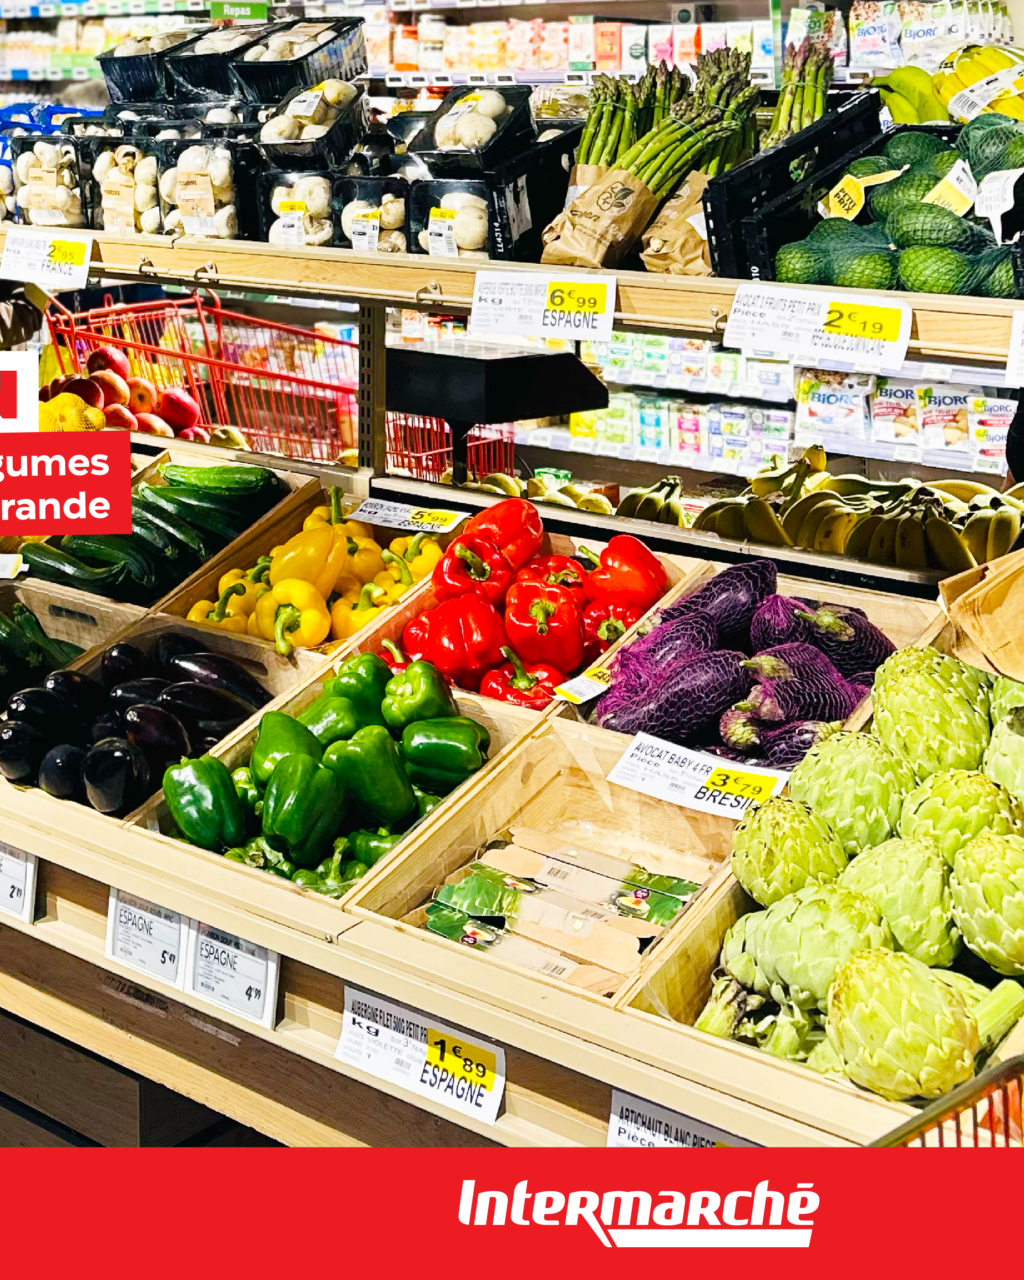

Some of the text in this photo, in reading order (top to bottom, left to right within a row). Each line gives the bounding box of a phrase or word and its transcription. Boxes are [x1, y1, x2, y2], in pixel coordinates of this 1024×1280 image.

[223, 4, 251, 18] Repas
[833, 192, 853, 214] PRIX
[838, 187, 858, 209] PETIT
[40, 260, 75, 276] FRANCE
[542, 308, 599, 329] ESPAGNE
[879, 387, 915, 400] BjOR
[629, 753, 661, 768] Pièce
[634, 741, 669, 761] AVOCAT
[668, 753, 693, 770] BABY
[692, 762, 698, 772] 4
[119, 908, 154, 937] ESPAGNE
[199, 941, 238, 972] ESPAGNE
[351, 999, 379, 1027] AUBERGINE
[379, 1008, 393, 1032] FILET
[351, 1017, 380, 1037] kg
[367, 1037, 403, 1056] VIOLETTE
[434, 1039, 487, 1078] 1€89
[419, 1060, 488, 1109] ESPAGNE
[617, 1126, 655, 1147] Pièce
[619, 1106, 663, 1138] ARTICHAUT
[663, 1123, 692, 1147] BLANC
